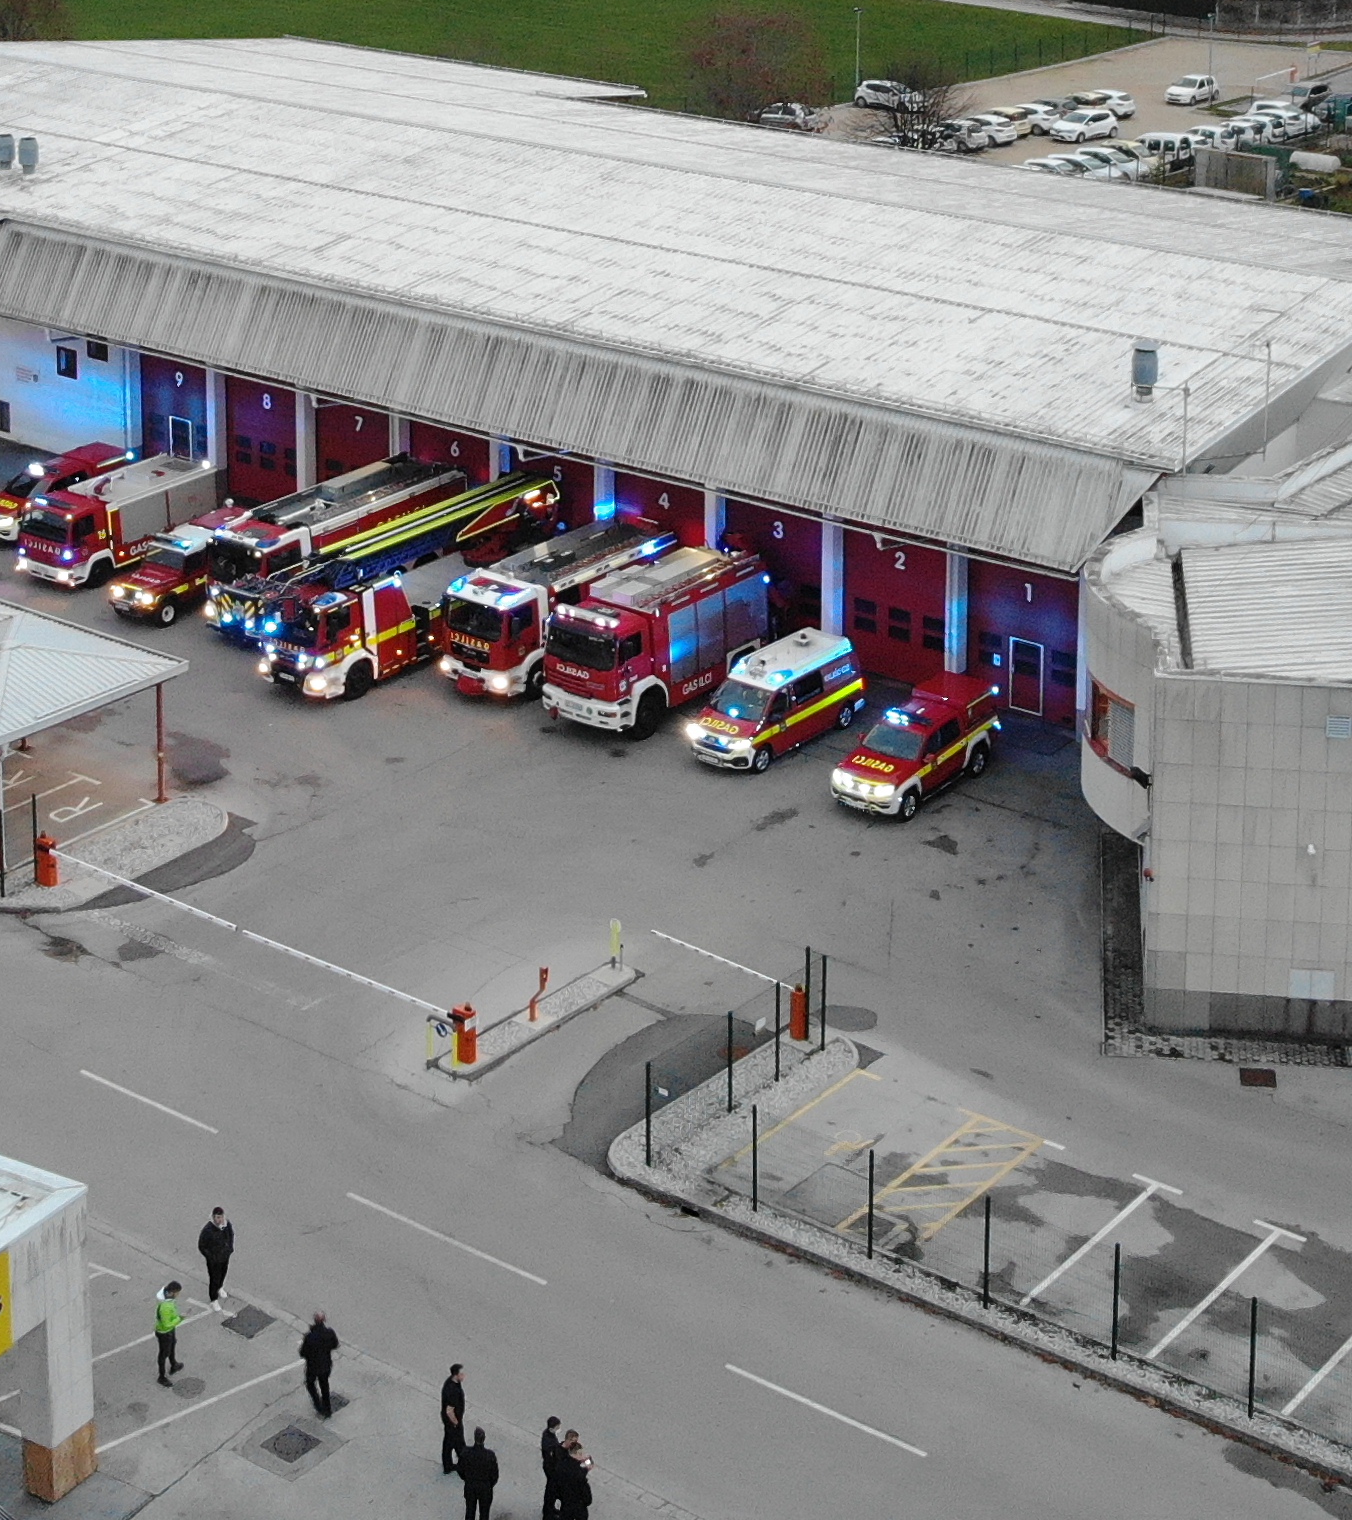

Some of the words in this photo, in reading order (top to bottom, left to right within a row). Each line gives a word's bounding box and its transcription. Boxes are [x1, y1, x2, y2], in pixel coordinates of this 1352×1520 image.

[176, 371, 184, 387] 9
[262, 394, 272, 410] 8
[355, 416, 363, 432] 7
[451, 441, 459, 457] 6
[553, 466, 562, 482] 5
[658, 493, 670, 509] 4
[773, 521, 784, 539] 3
[894, 551, 906, 570] 2
[1024, 583, 1032, 602] 1
[682, 672, 712, 695] GASILCI
[50, 797, 104, 823] R
